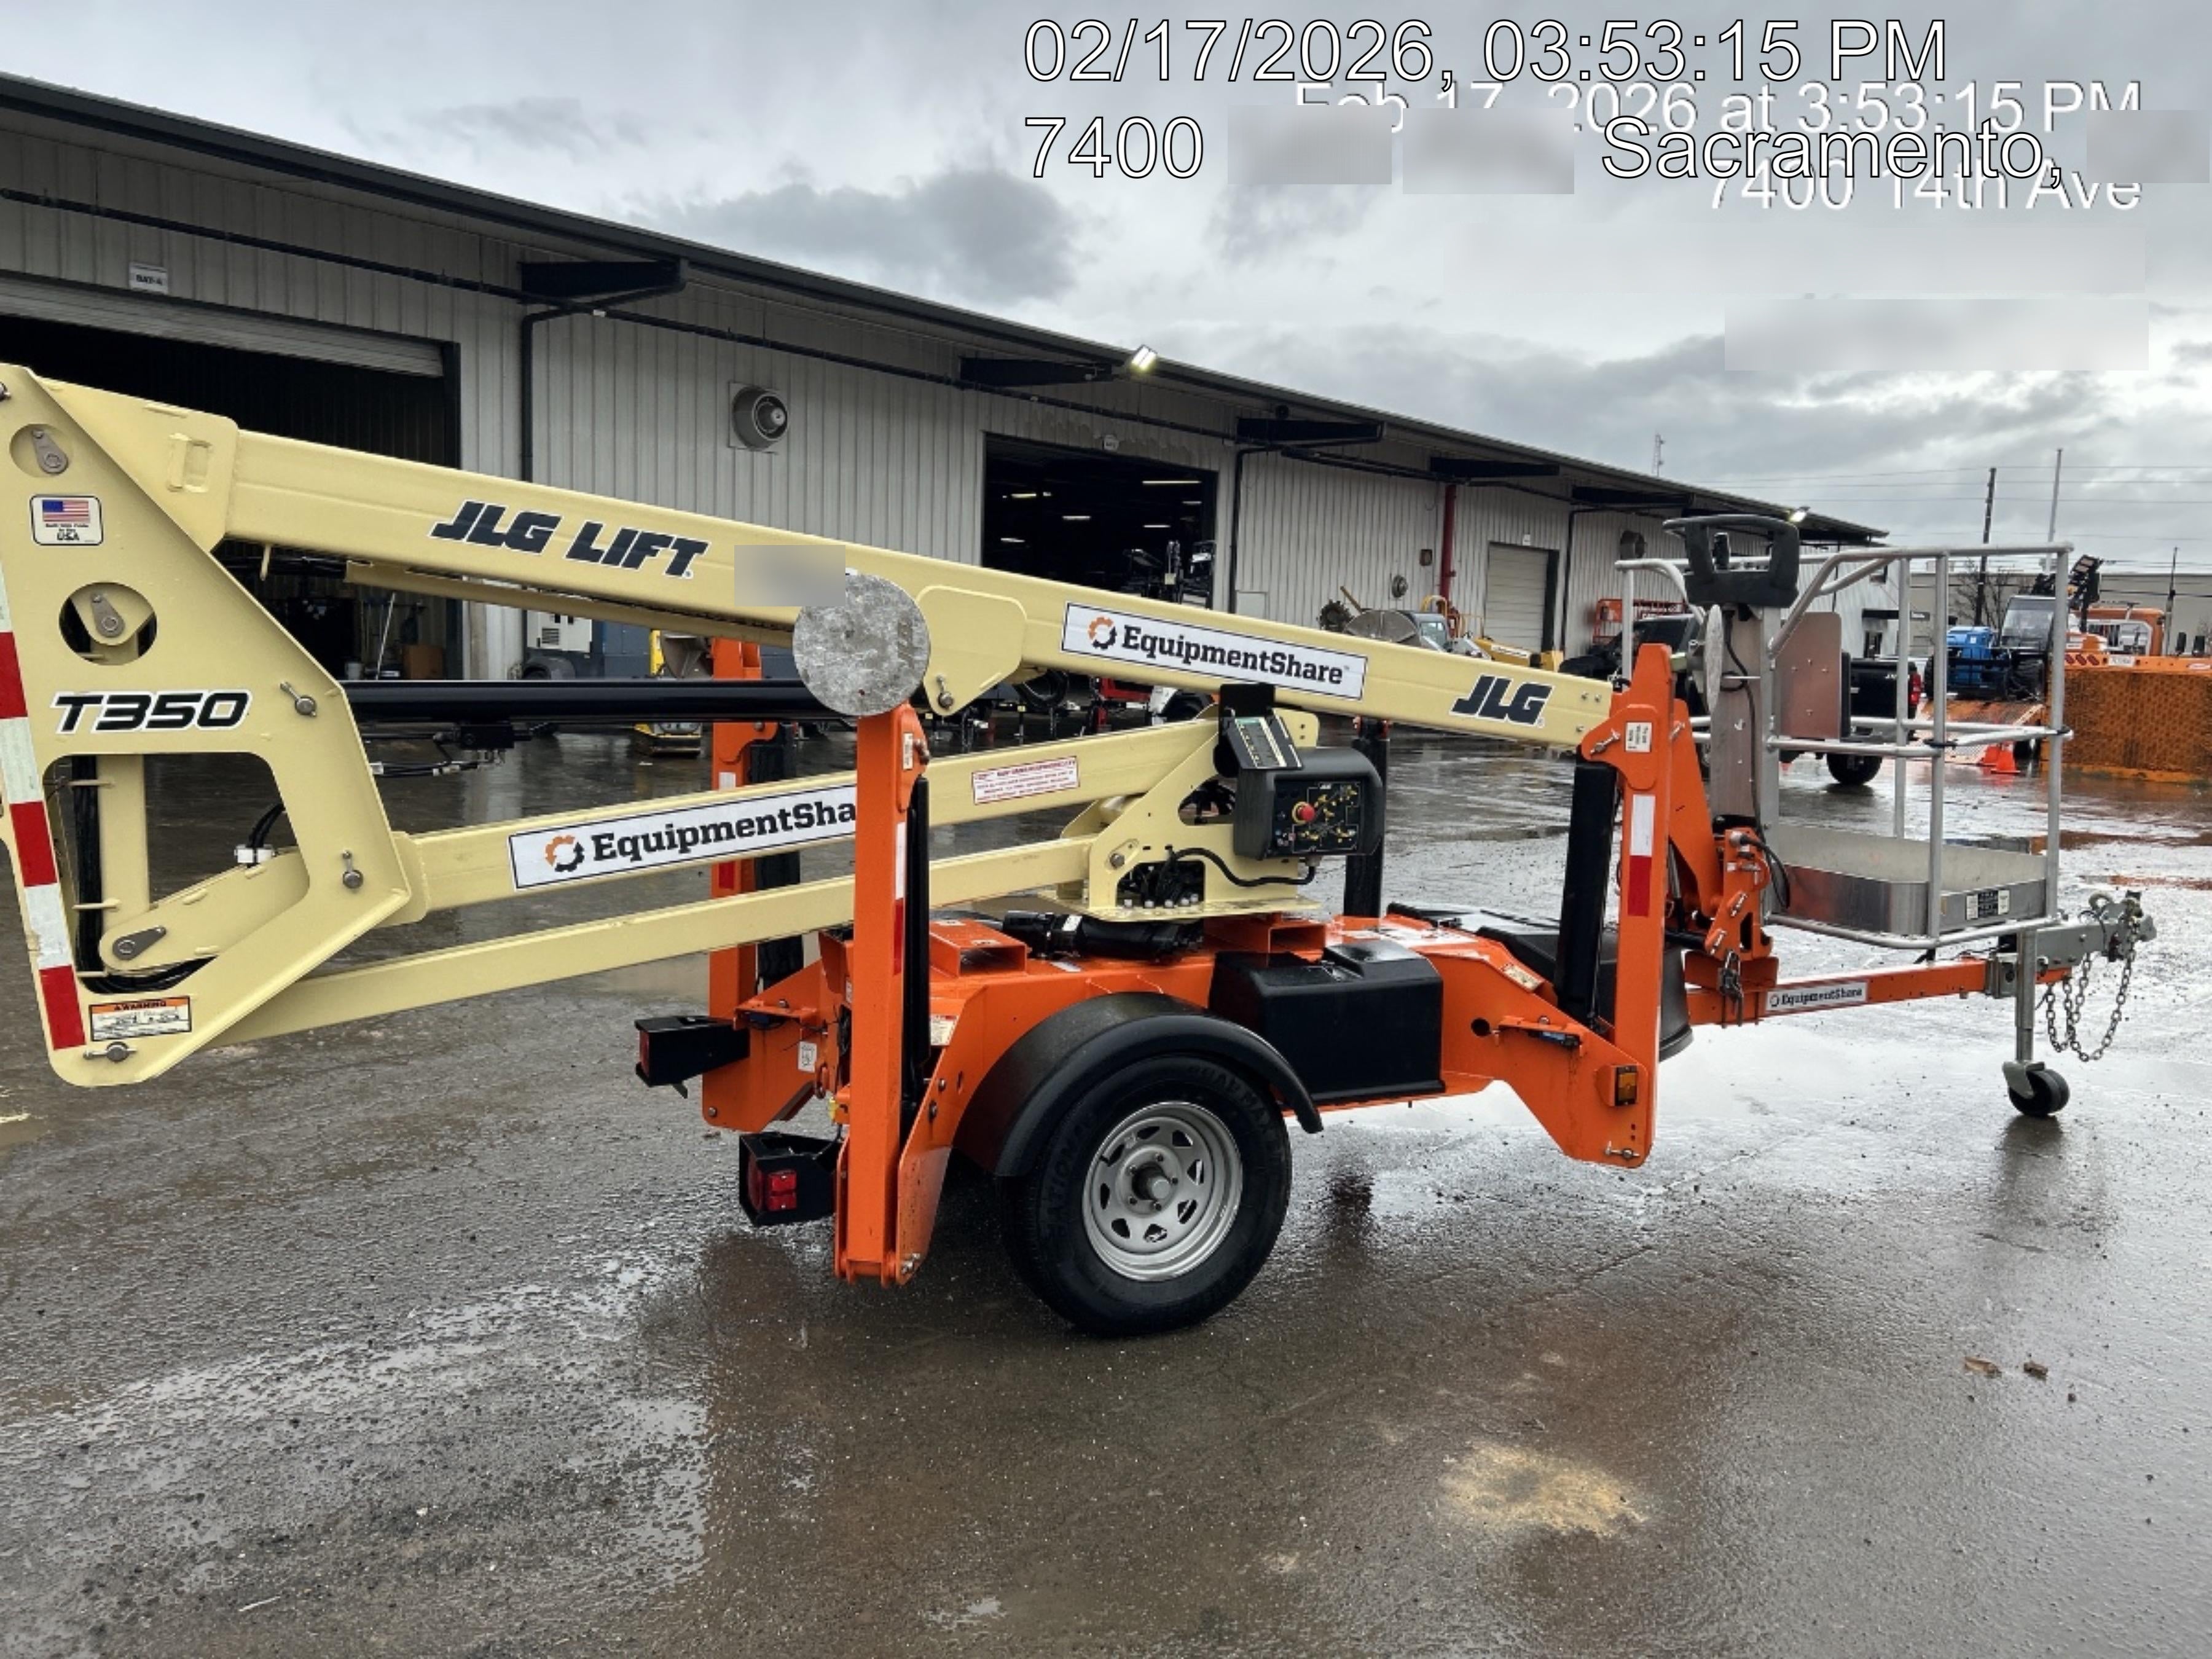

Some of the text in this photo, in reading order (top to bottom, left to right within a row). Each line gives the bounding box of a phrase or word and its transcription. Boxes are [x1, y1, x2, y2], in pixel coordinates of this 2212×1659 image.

[429, 500, 711, 577] JLG LIFT
[1122, 624, 1344, 684] EquipmentShare
[54, 692, 249, 732] T350
[1450, 674, 1554, 726] JLG
